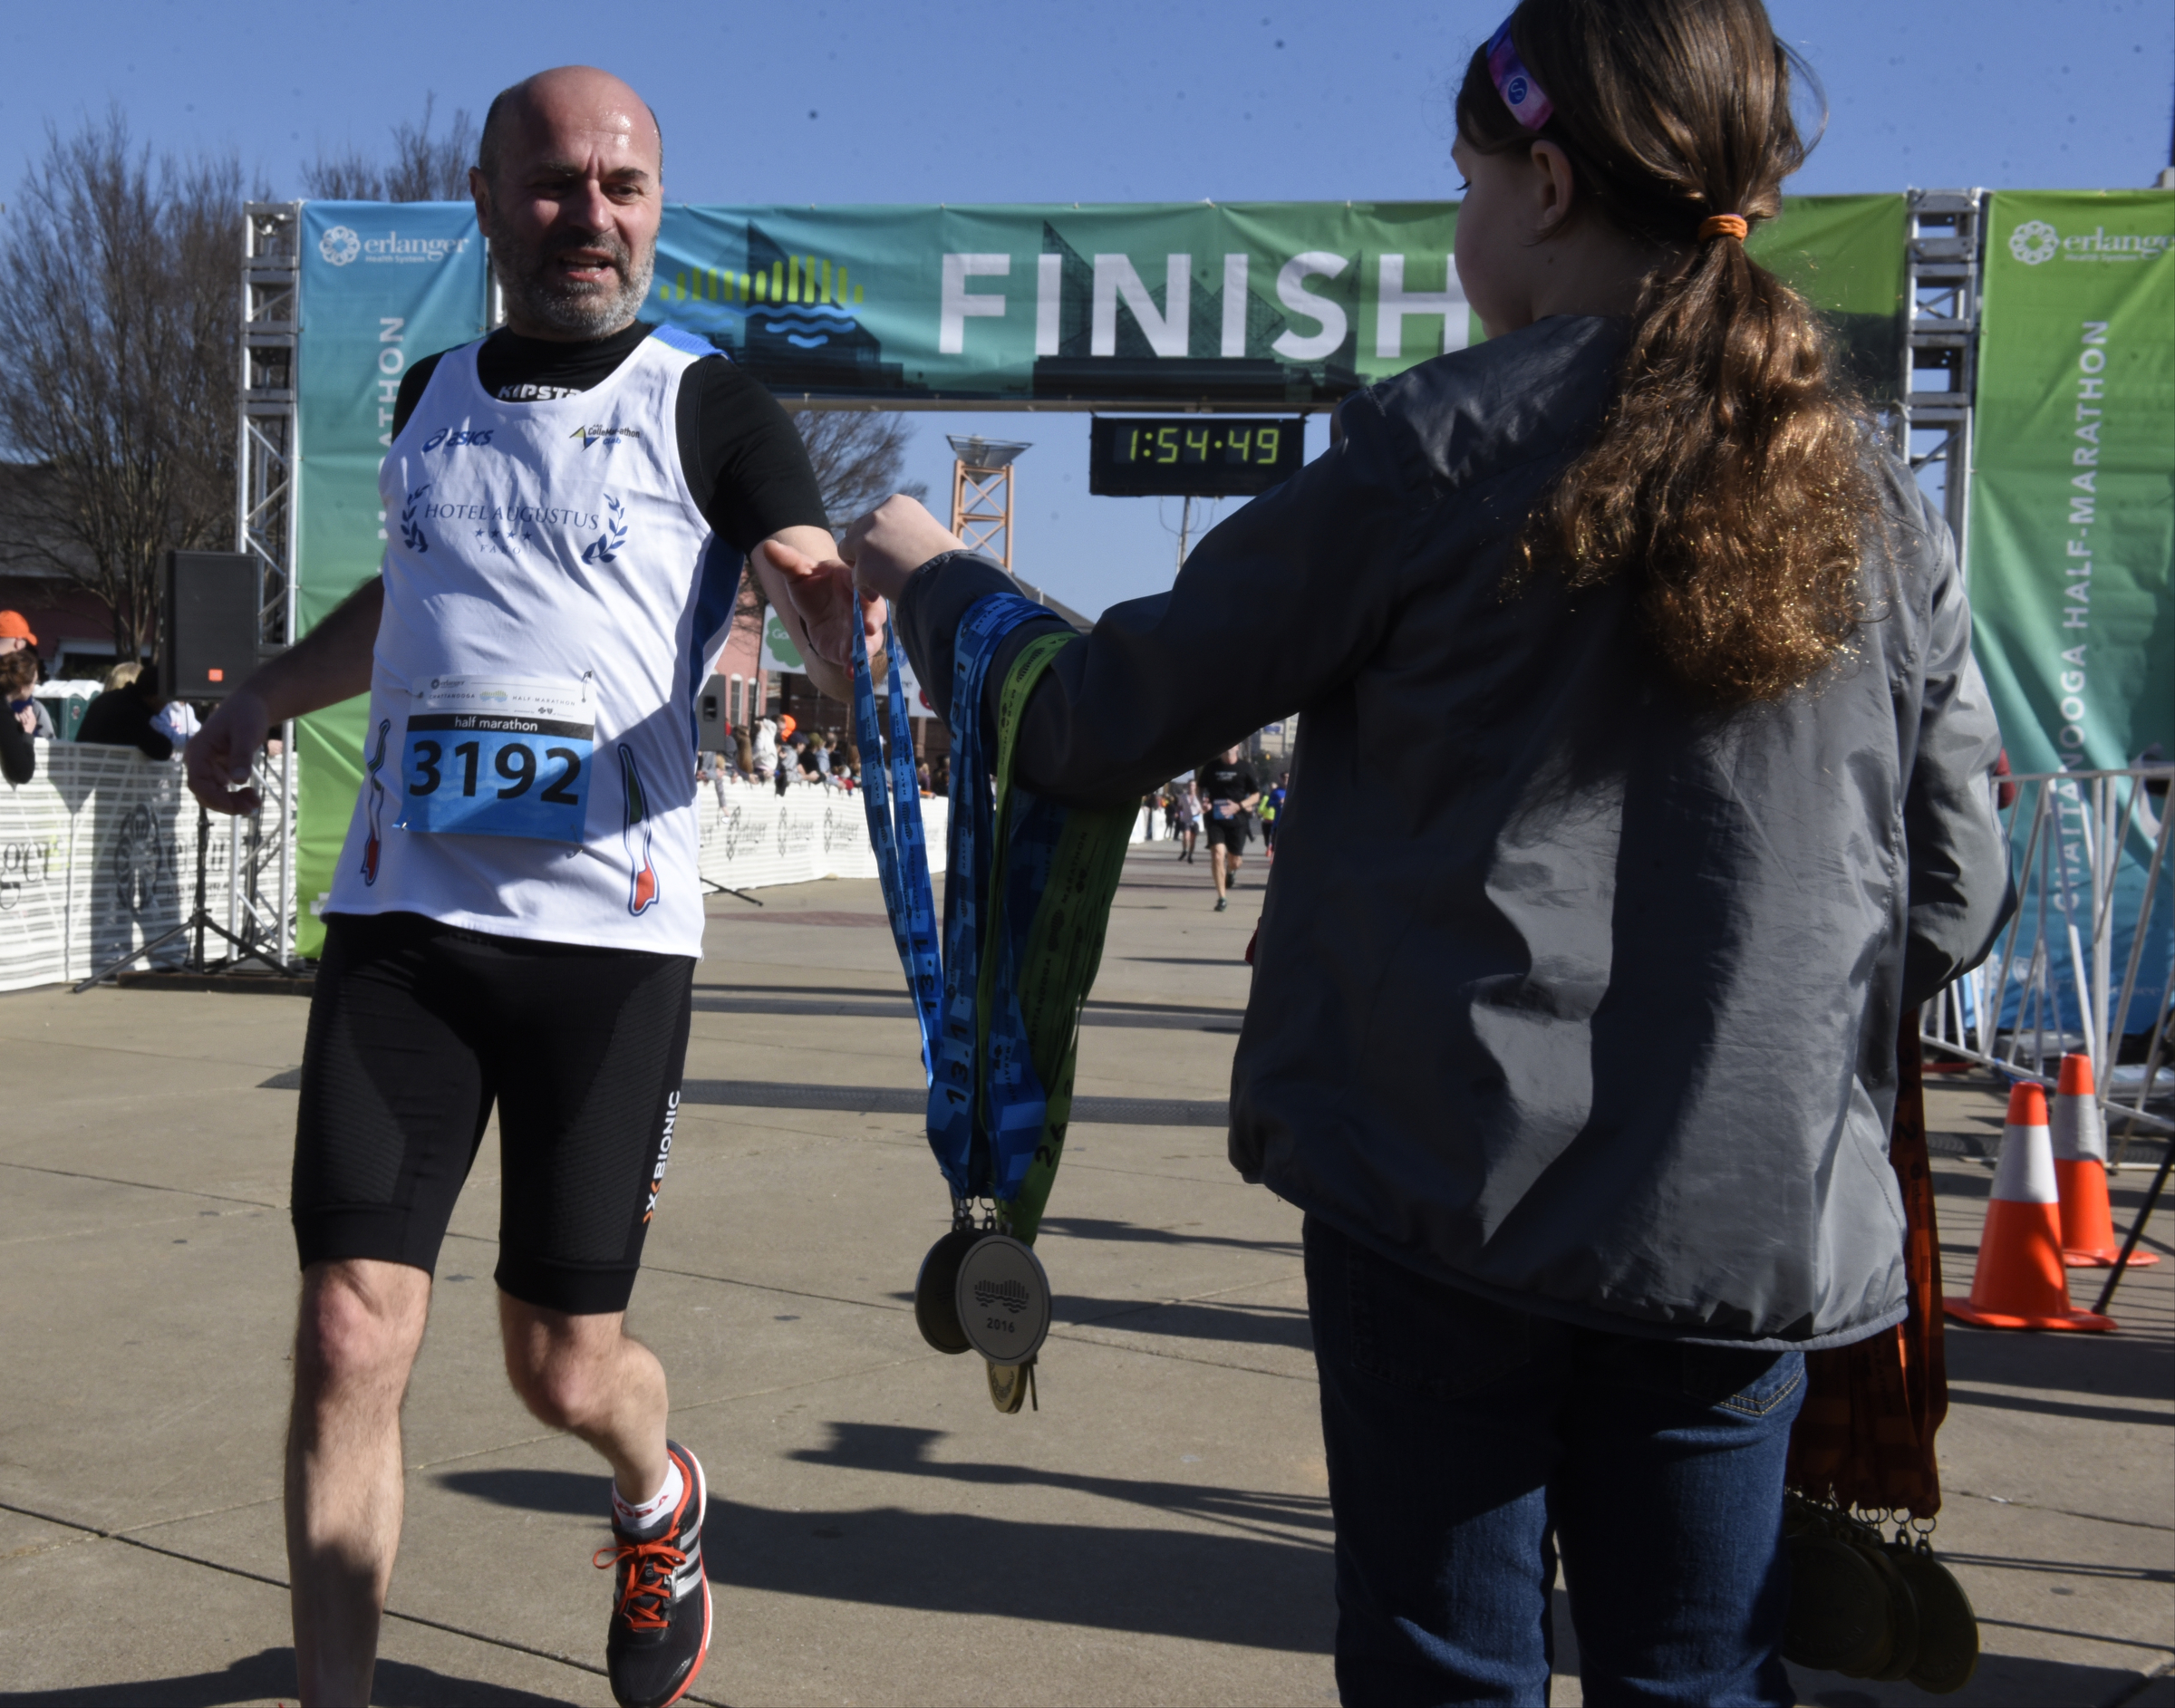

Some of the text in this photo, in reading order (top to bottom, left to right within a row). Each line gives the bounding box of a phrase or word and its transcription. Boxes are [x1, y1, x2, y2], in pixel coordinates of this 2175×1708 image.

[364, 231, 469, 262] erlanger
[939, 250, 1471, 361] FINISH
[2063, 321, 2109, 628] HALF-MARATHON
[424, 503, 600, 531] HOTEL AUGUSTUS
[479, 544, 521, 555] FANO
[455, 716, 538, 732] half marathon
[512, 695, 575, 706] HALF-MARATHON
[409, 739, 582, 806] 3192
[1060, 831, 1088, 904] MARATHON
[914, 939, 937, 1015] 13.1
[946, 1023, 969, 1105] 13.1
[652, 1090, 681, 1180] BIONIC
[986, 1317, 1016, 1334] 2016
